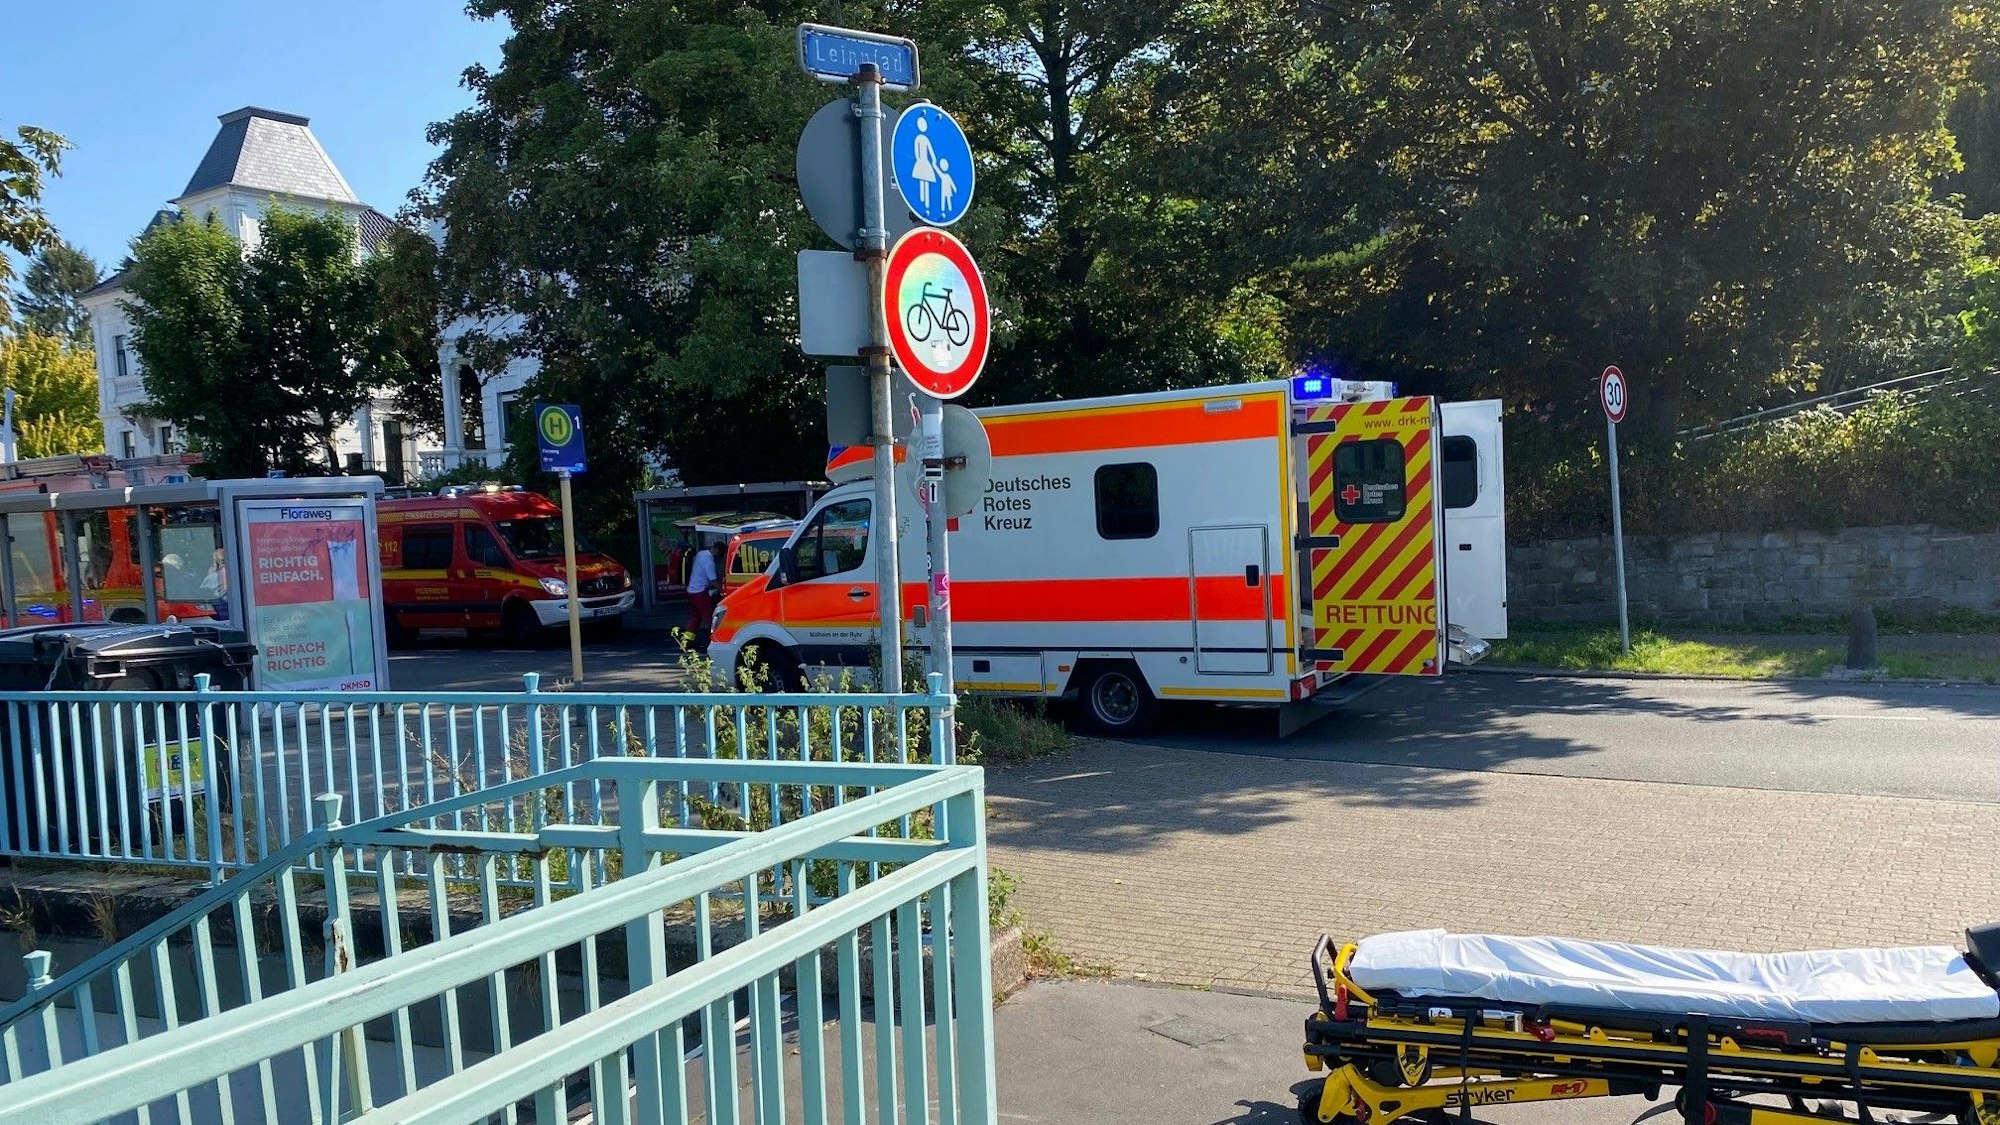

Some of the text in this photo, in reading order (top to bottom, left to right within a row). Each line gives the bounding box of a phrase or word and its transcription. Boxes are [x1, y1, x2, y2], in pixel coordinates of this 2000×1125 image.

[1606, 382, 1621, 406] 30
[549, 416, 564, 435] H
[574, 415, 581, 430] 1
[983, 497, 1031, 512] Rotes
[281, 508, 332, 520] Floraweg
[984, 515, 1032, 531] Kreuz
[384, 541, 398, 552] 112
[259, 555, 319, 569] RICHTIG
[260, 570, 324, 584] EINFACH.
[266, 641, 325, 657] EINFACH
[267, 656, 330, 671] RICHTIG.
